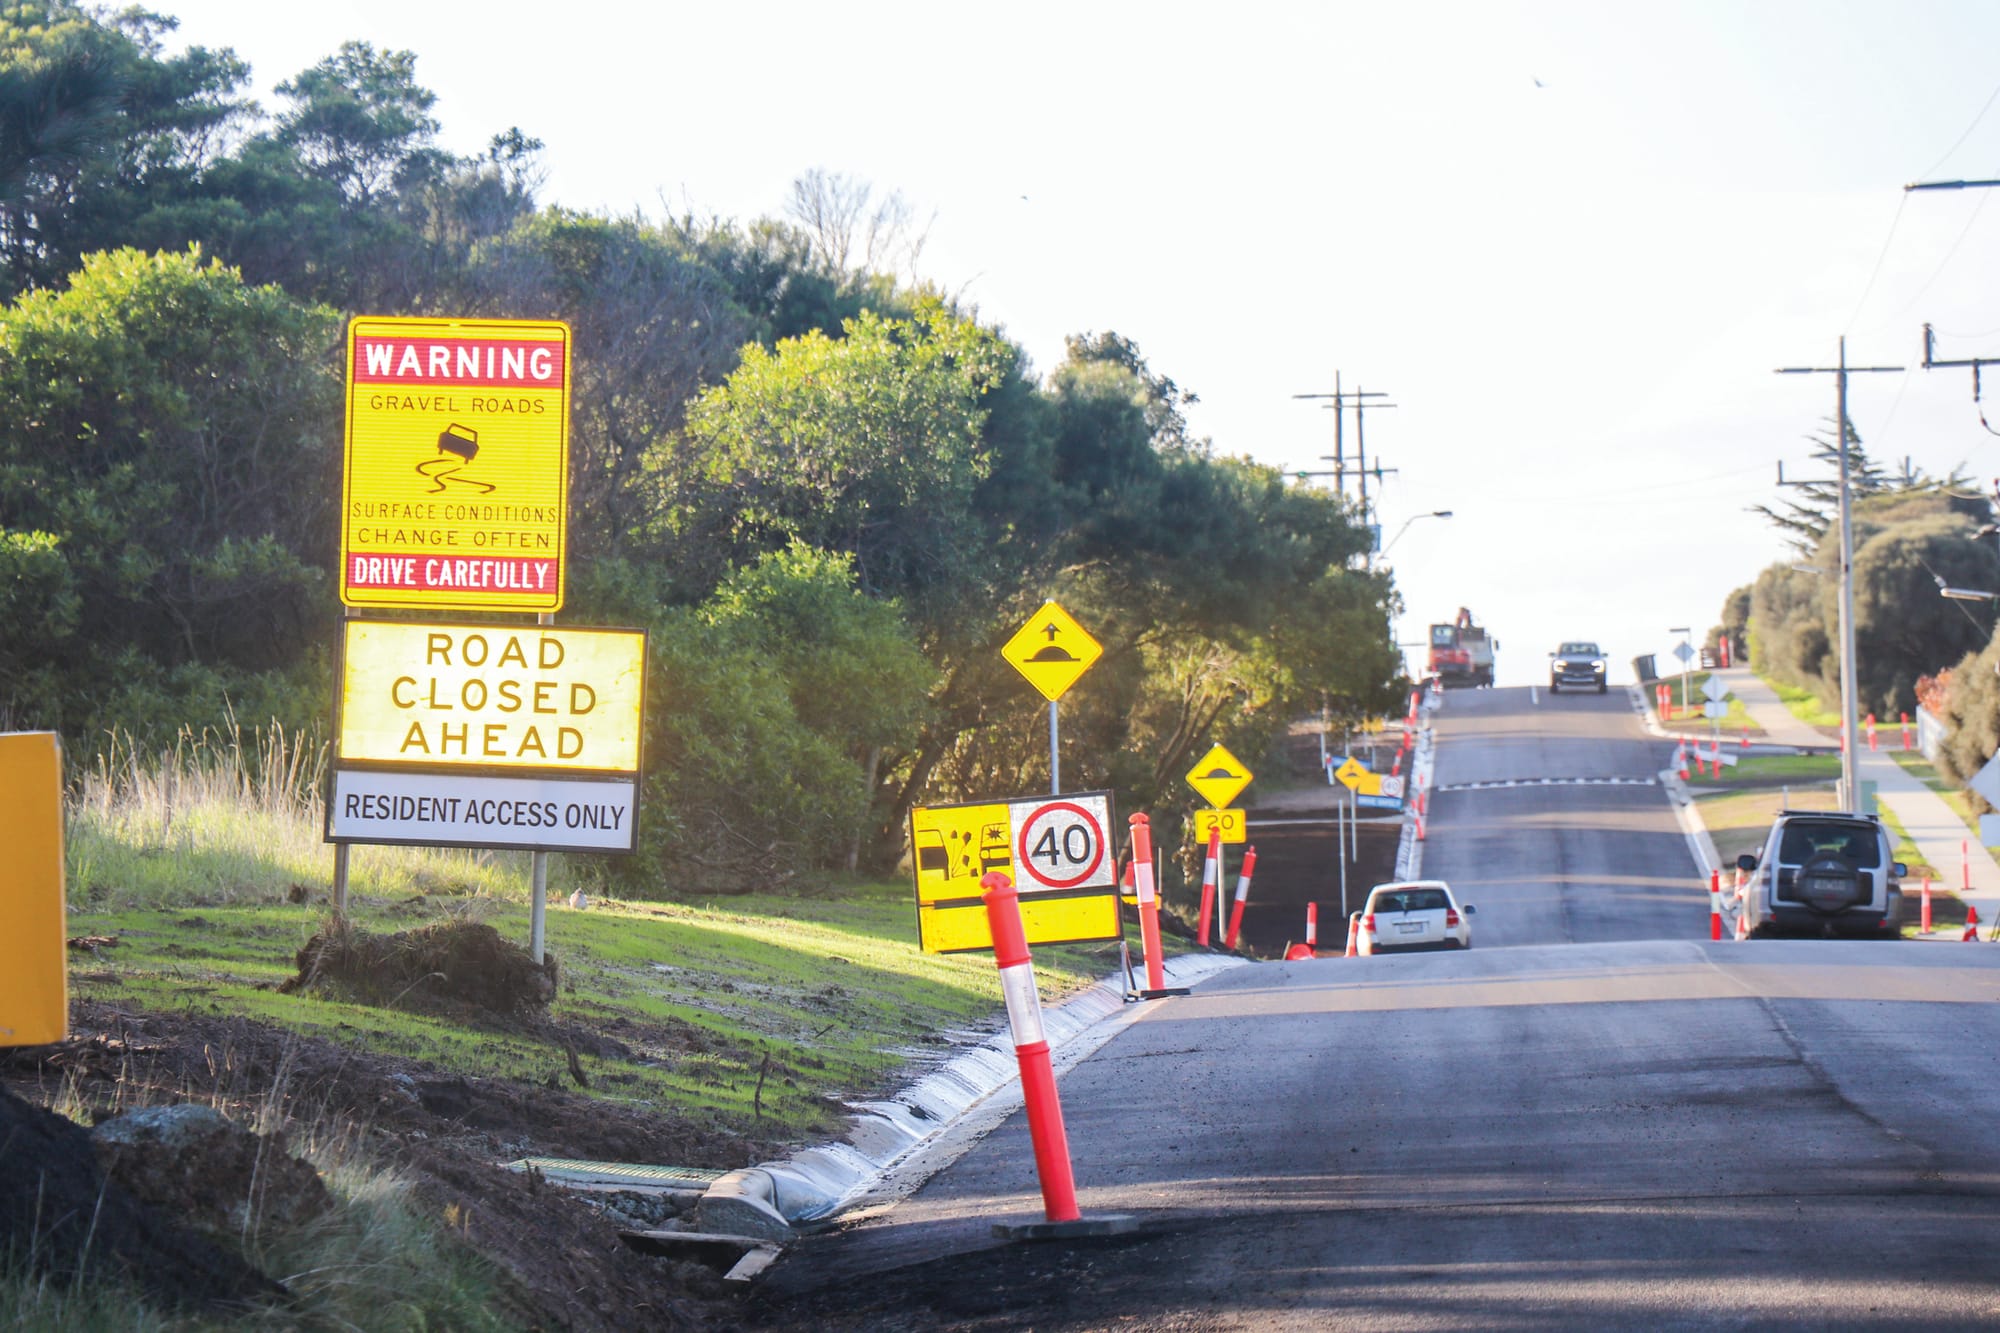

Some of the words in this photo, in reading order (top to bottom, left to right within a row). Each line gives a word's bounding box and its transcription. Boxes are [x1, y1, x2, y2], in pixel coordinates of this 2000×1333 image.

[365, 343, 553, 380] WARNING
[370, 395, 460, 412] GRAVEL
[472, 397, 546, 414] ROADS
[352, 502, 436, 520] SURFACE
[444, 505, 557, 523] CONDITIONS
[358, 528, 459, 546] CHANGE
[473, 531, 550, 548] OFTEN
[354, 557, 416, 585] DRIVE
[425, 559, 549, 589] CAREFULLY
[426, 633, 565, 669] ROAD
[391, 676, 597, 715] CLOSED
[400, 721, 584, 759] AHEAD
[345, 793, 461, 823] RESIDENT
[464, 799, 558, 828] ACCESS
[565, 803, 625, 831] ONLY
[1206, 814, 1234, 830] 20
[1031, 824, 1091, 866] 40
